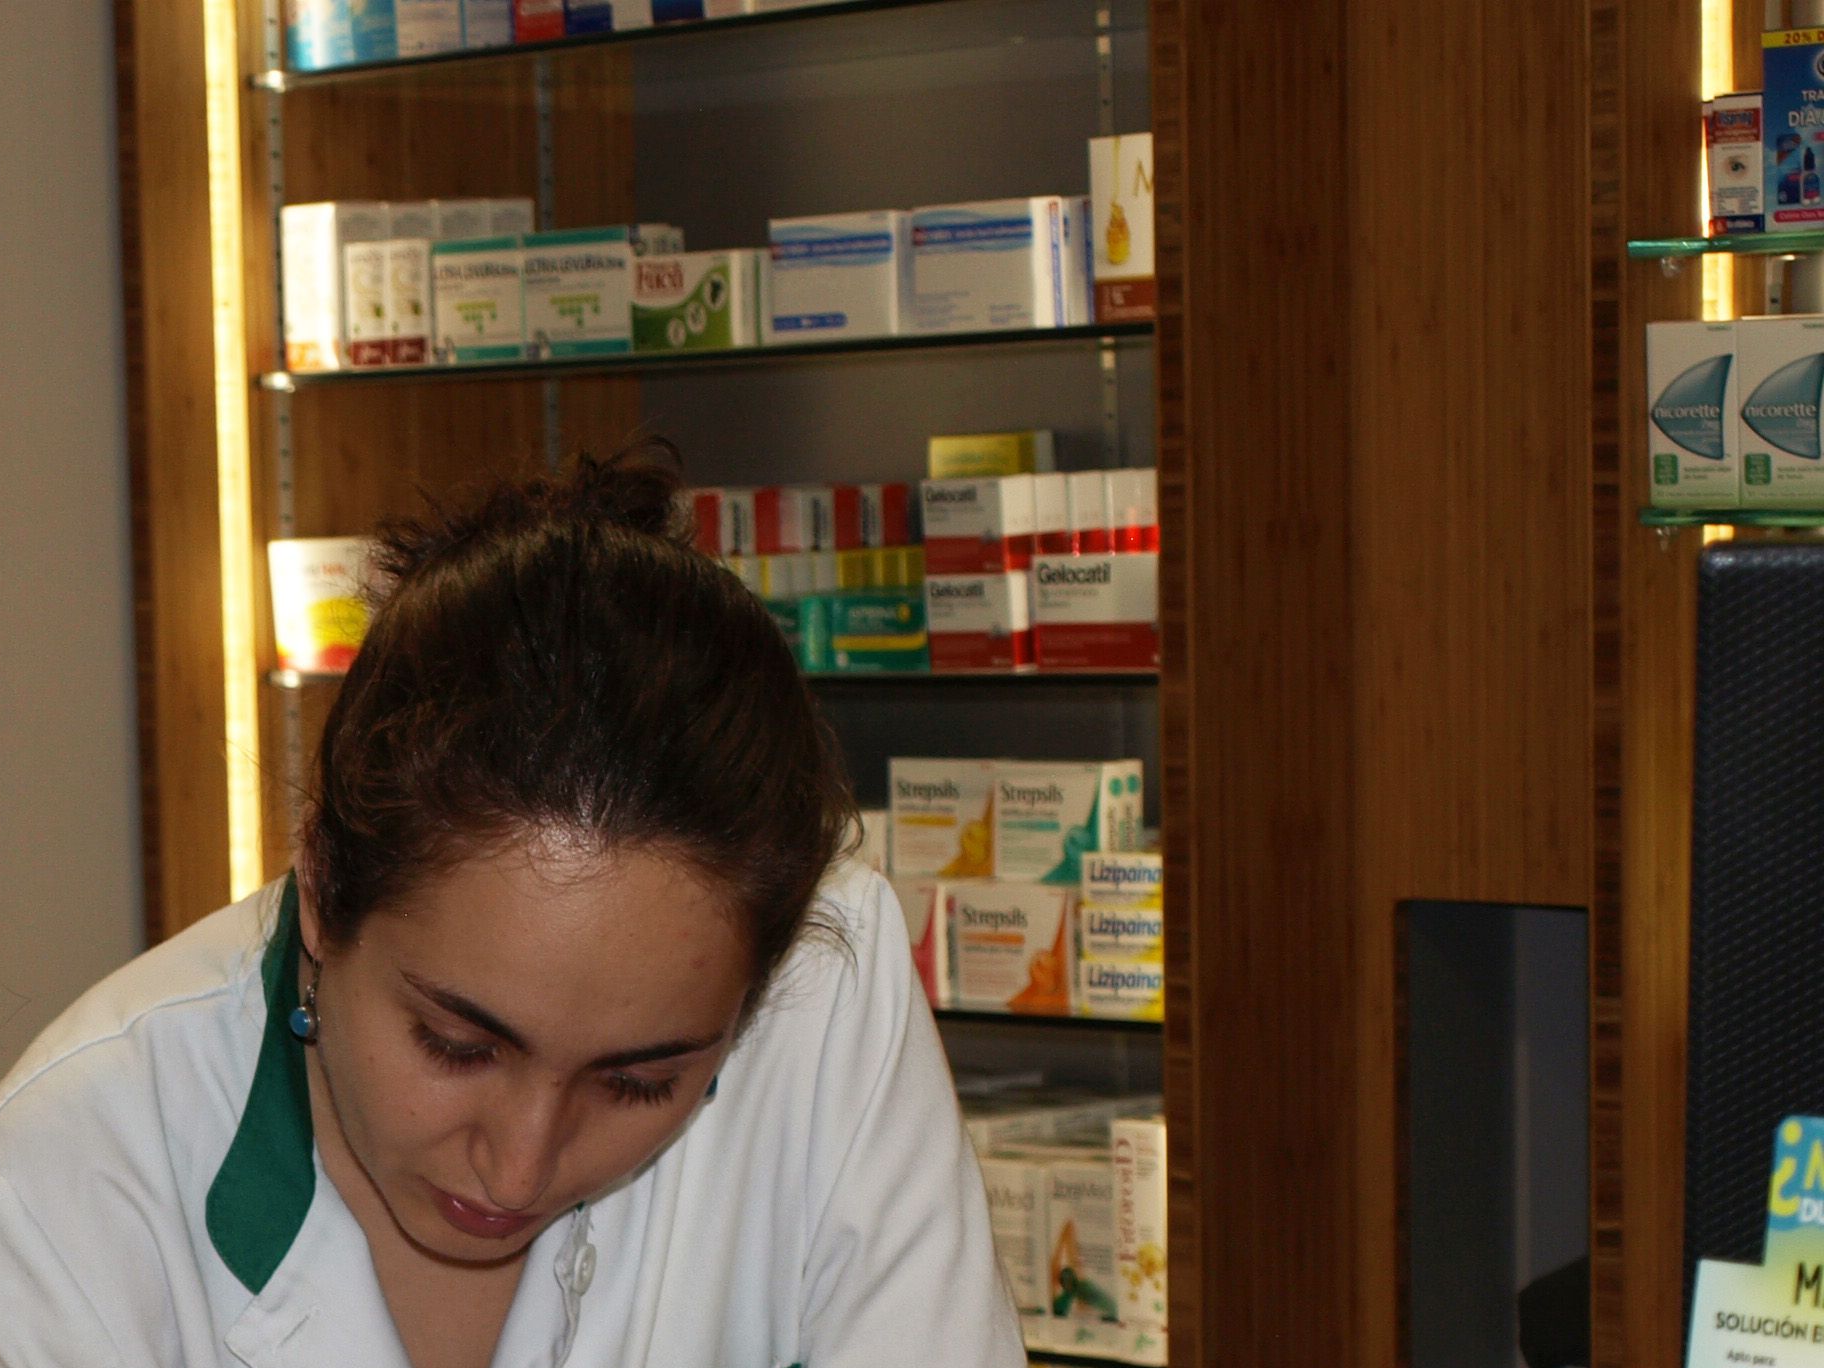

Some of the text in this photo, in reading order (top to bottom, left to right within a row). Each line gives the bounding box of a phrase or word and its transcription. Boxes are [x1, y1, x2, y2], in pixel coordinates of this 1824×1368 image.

[1654, 404, 1720, 419] nicorette
[1744, 403, 1817, 418] nicorette
[926, 487, 977, 503] Gelocatil
[1037, 562, 1112, 585] Gelocatil
[930, 581, 985, 598] Gelocatil
[897, 779, 960, 805] Strepsils
[1000, 782, 1064, 806] Strepsils
[961, 904, 1028, 932] Strepsils
[1716, 1311, 1808, 1341] SOLUCIÓN
